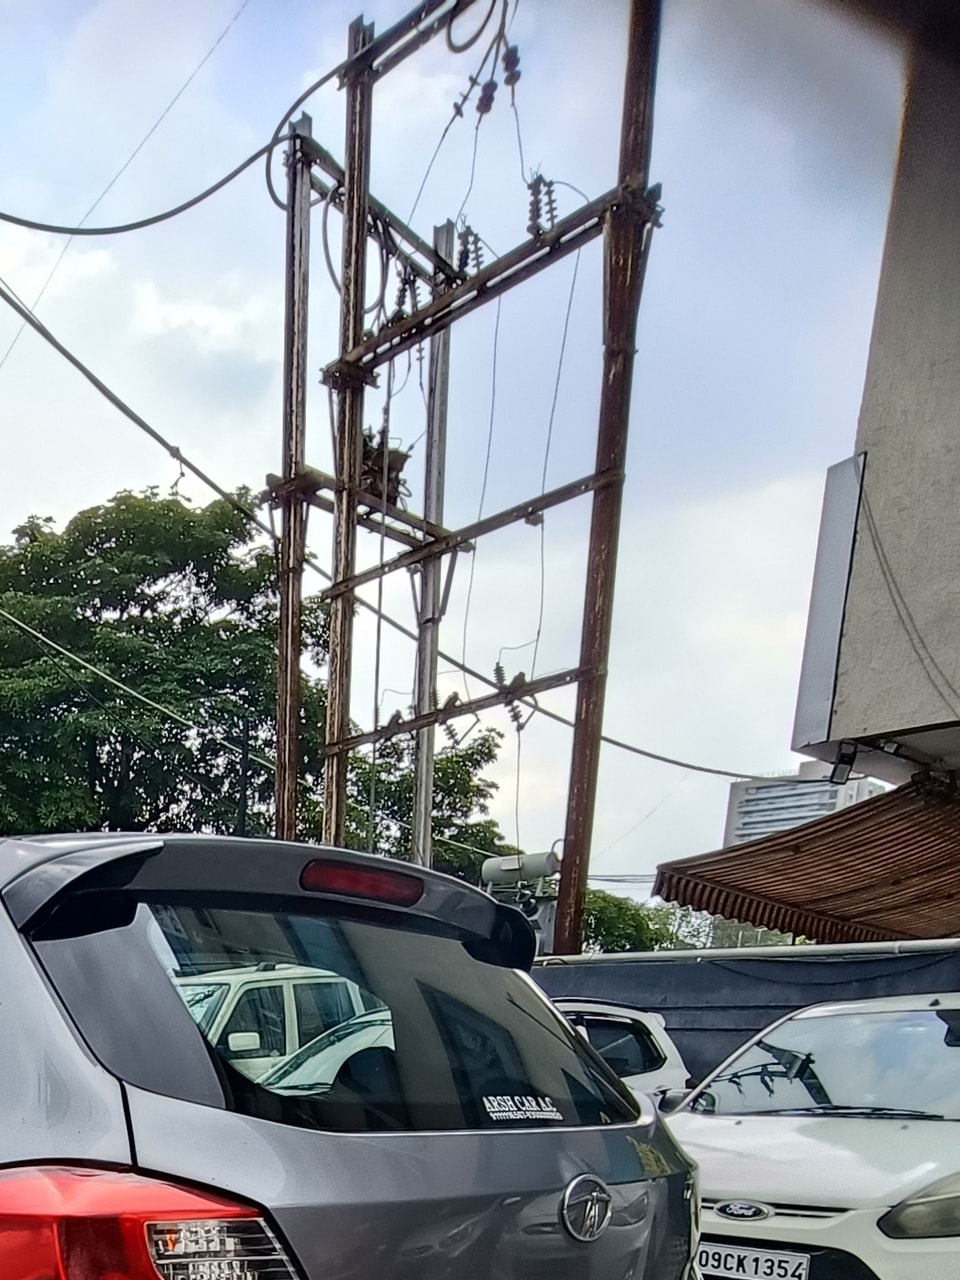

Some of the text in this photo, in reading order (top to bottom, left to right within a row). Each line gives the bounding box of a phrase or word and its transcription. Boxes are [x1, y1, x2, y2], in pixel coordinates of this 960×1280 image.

[482, 1095, 518, 1112] ARSH
[514, 1095, 541, 1111] CAR
[725, 1202, 758, 1216] Ford
[698, 1249, 805, 1280] 09CK1354
